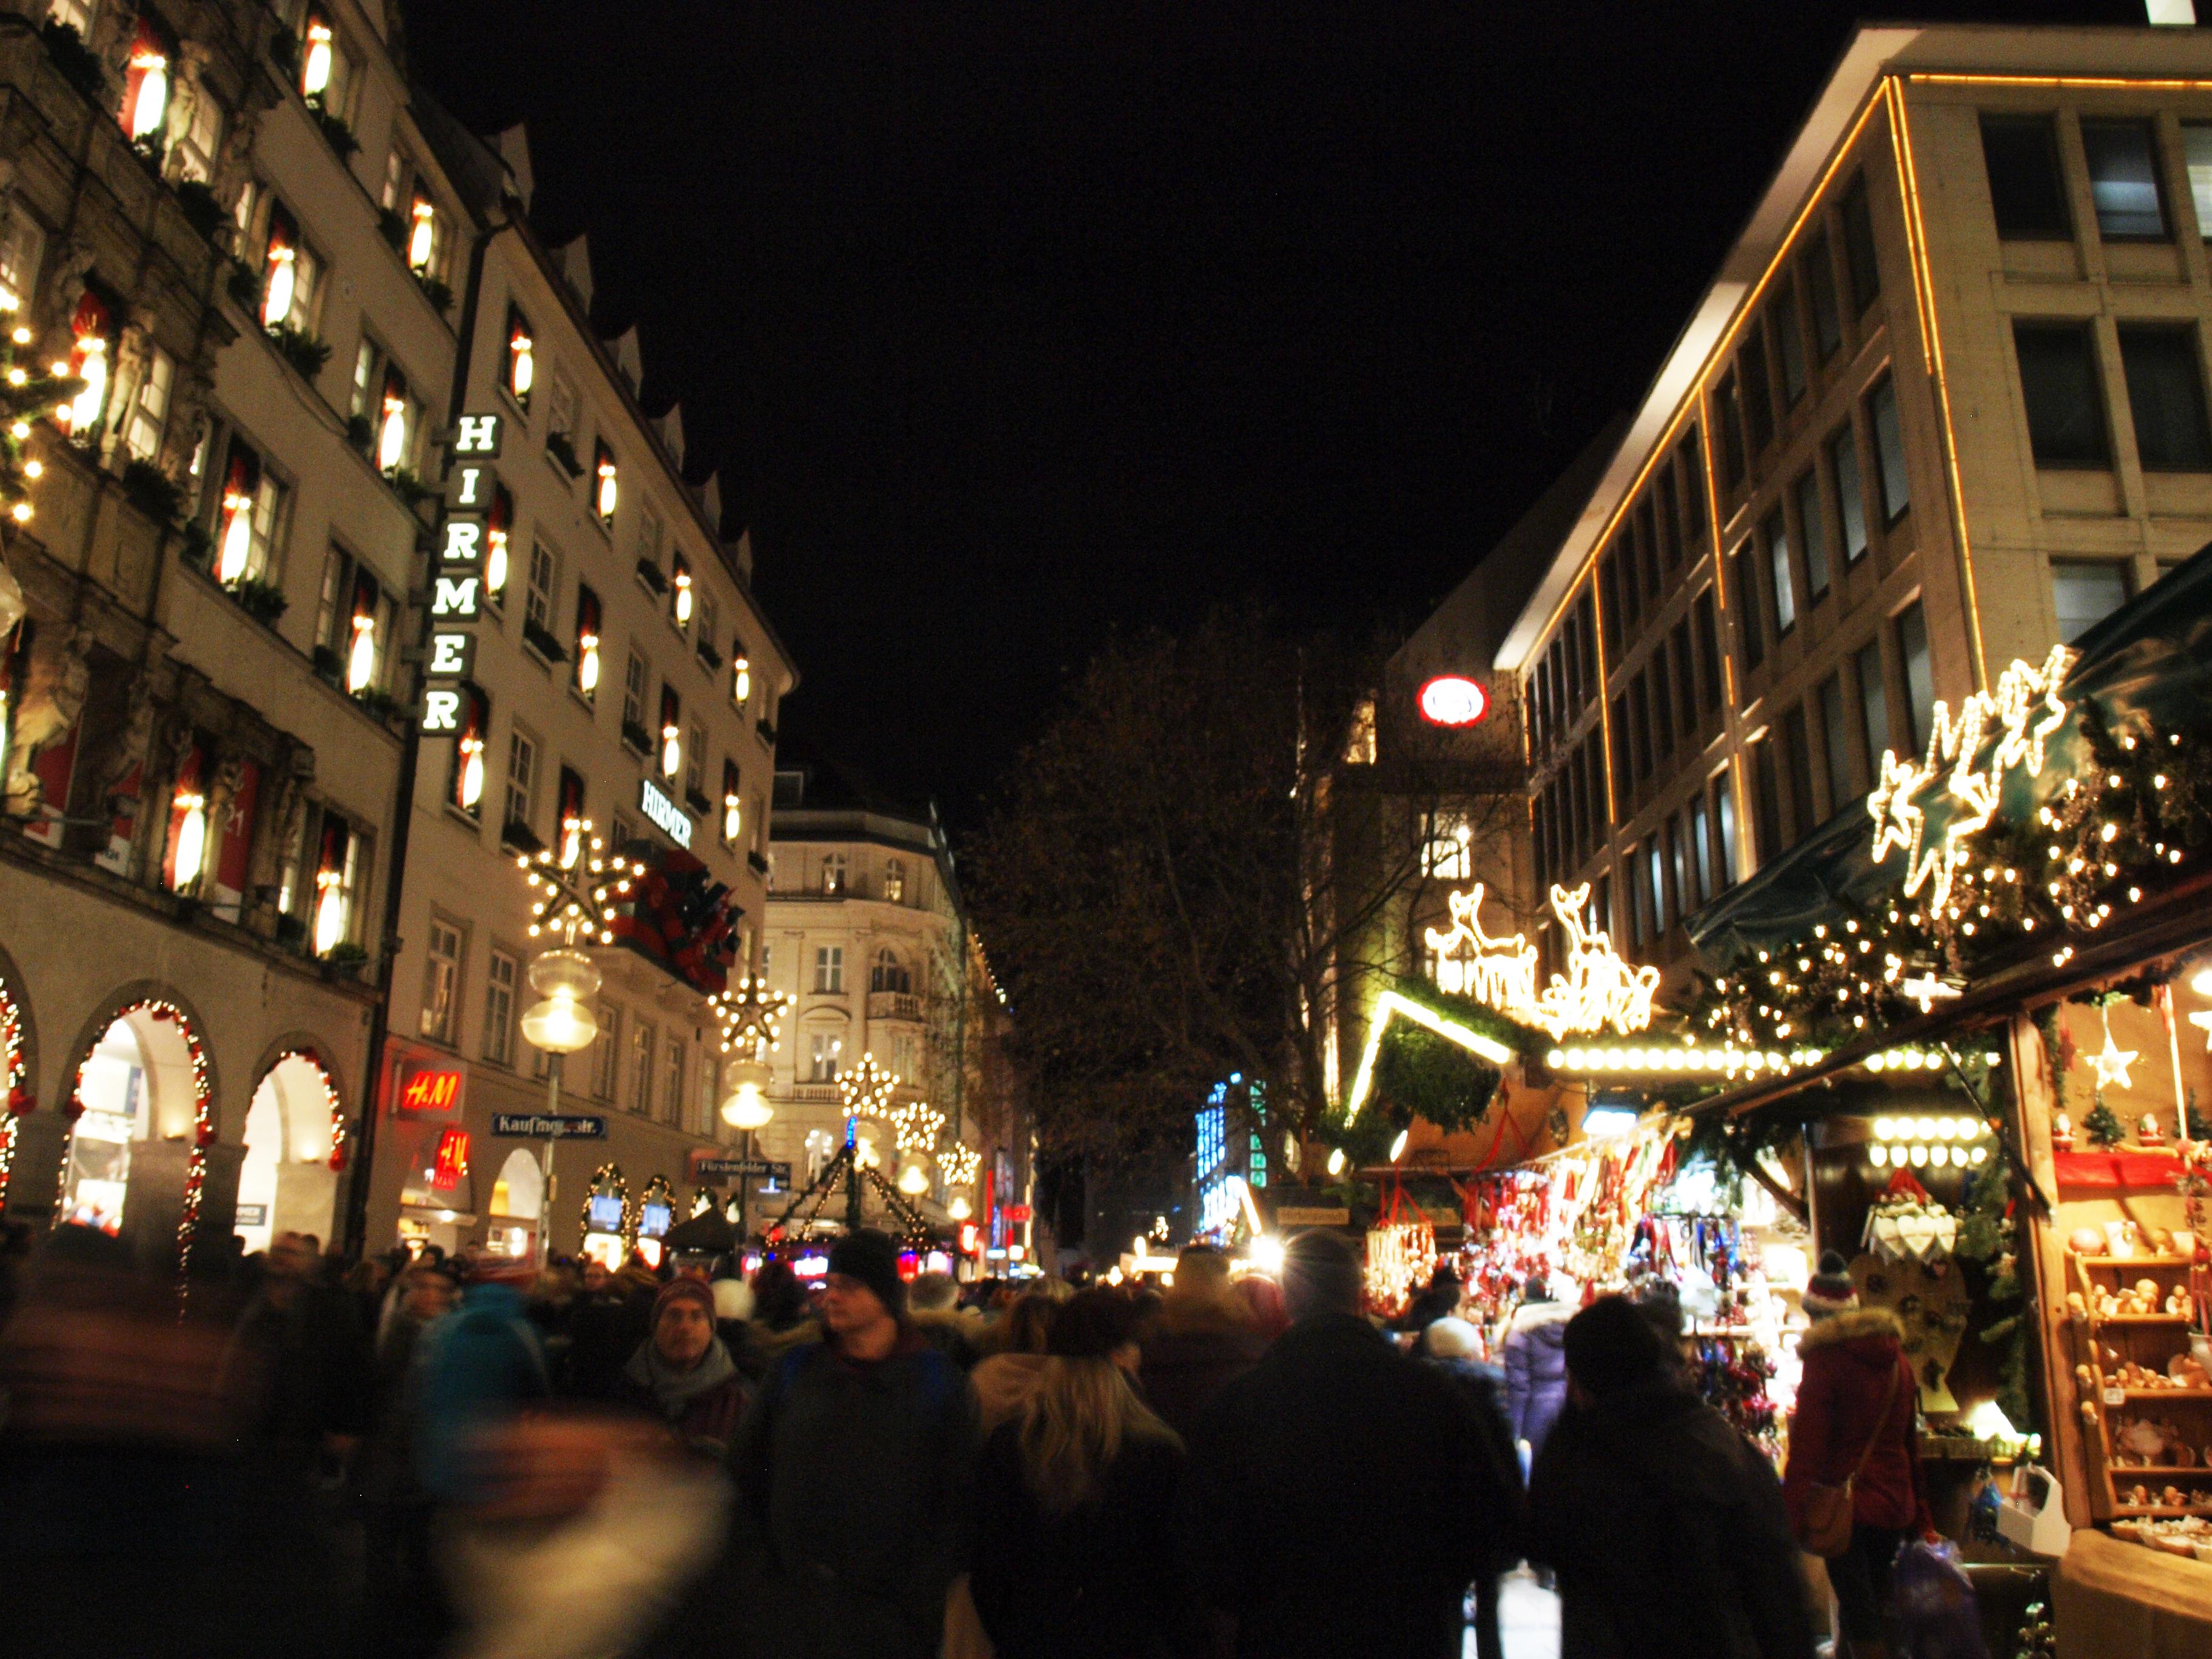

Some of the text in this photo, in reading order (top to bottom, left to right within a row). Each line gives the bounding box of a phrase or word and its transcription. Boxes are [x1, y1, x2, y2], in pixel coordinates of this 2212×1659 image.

[423, 416, 497, 729] HIRMER
[642, 779, 692, 850] HIRMER
[405, 1073, 459, 1110] H&M
[499, 1116, 597, 1137] Kaufingstr.
